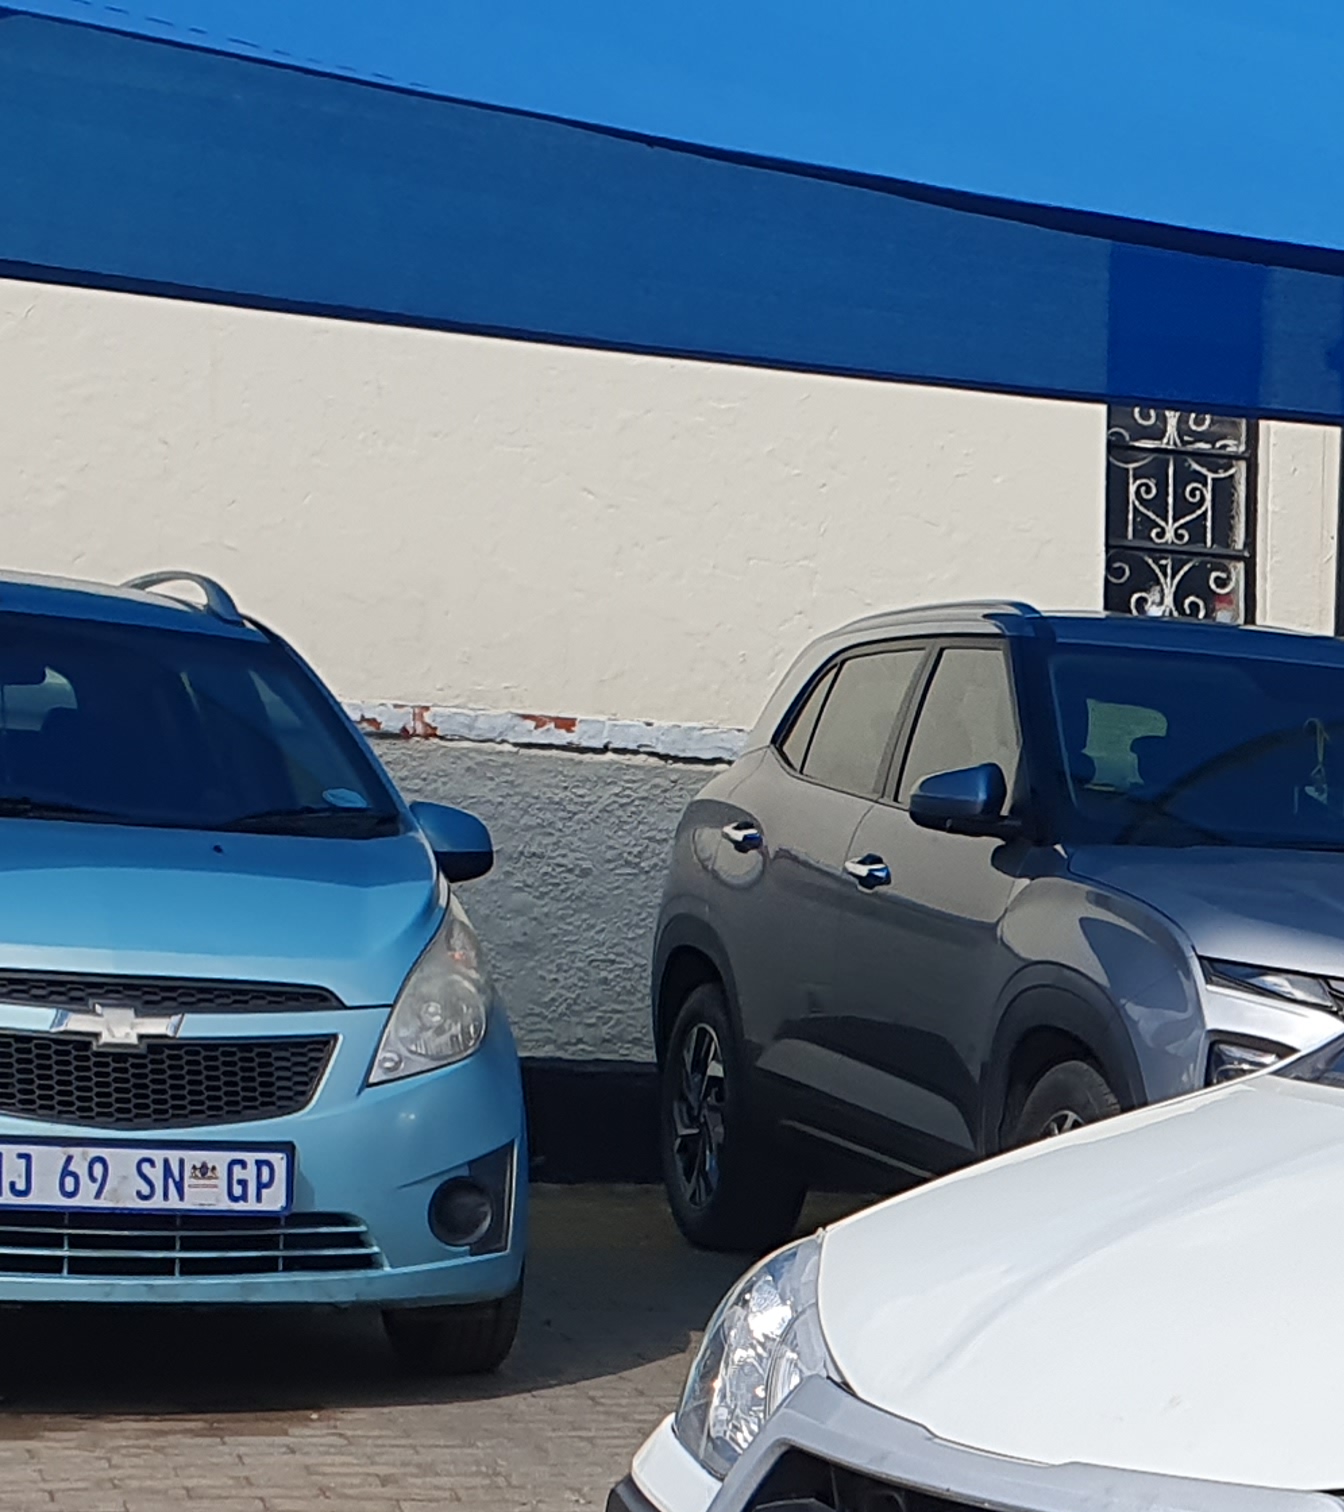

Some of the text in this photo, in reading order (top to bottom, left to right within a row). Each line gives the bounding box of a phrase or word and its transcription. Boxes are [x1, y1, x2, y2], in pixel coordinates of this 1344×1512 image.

[0, 1152, 275, 1204] J 69 SN GP
